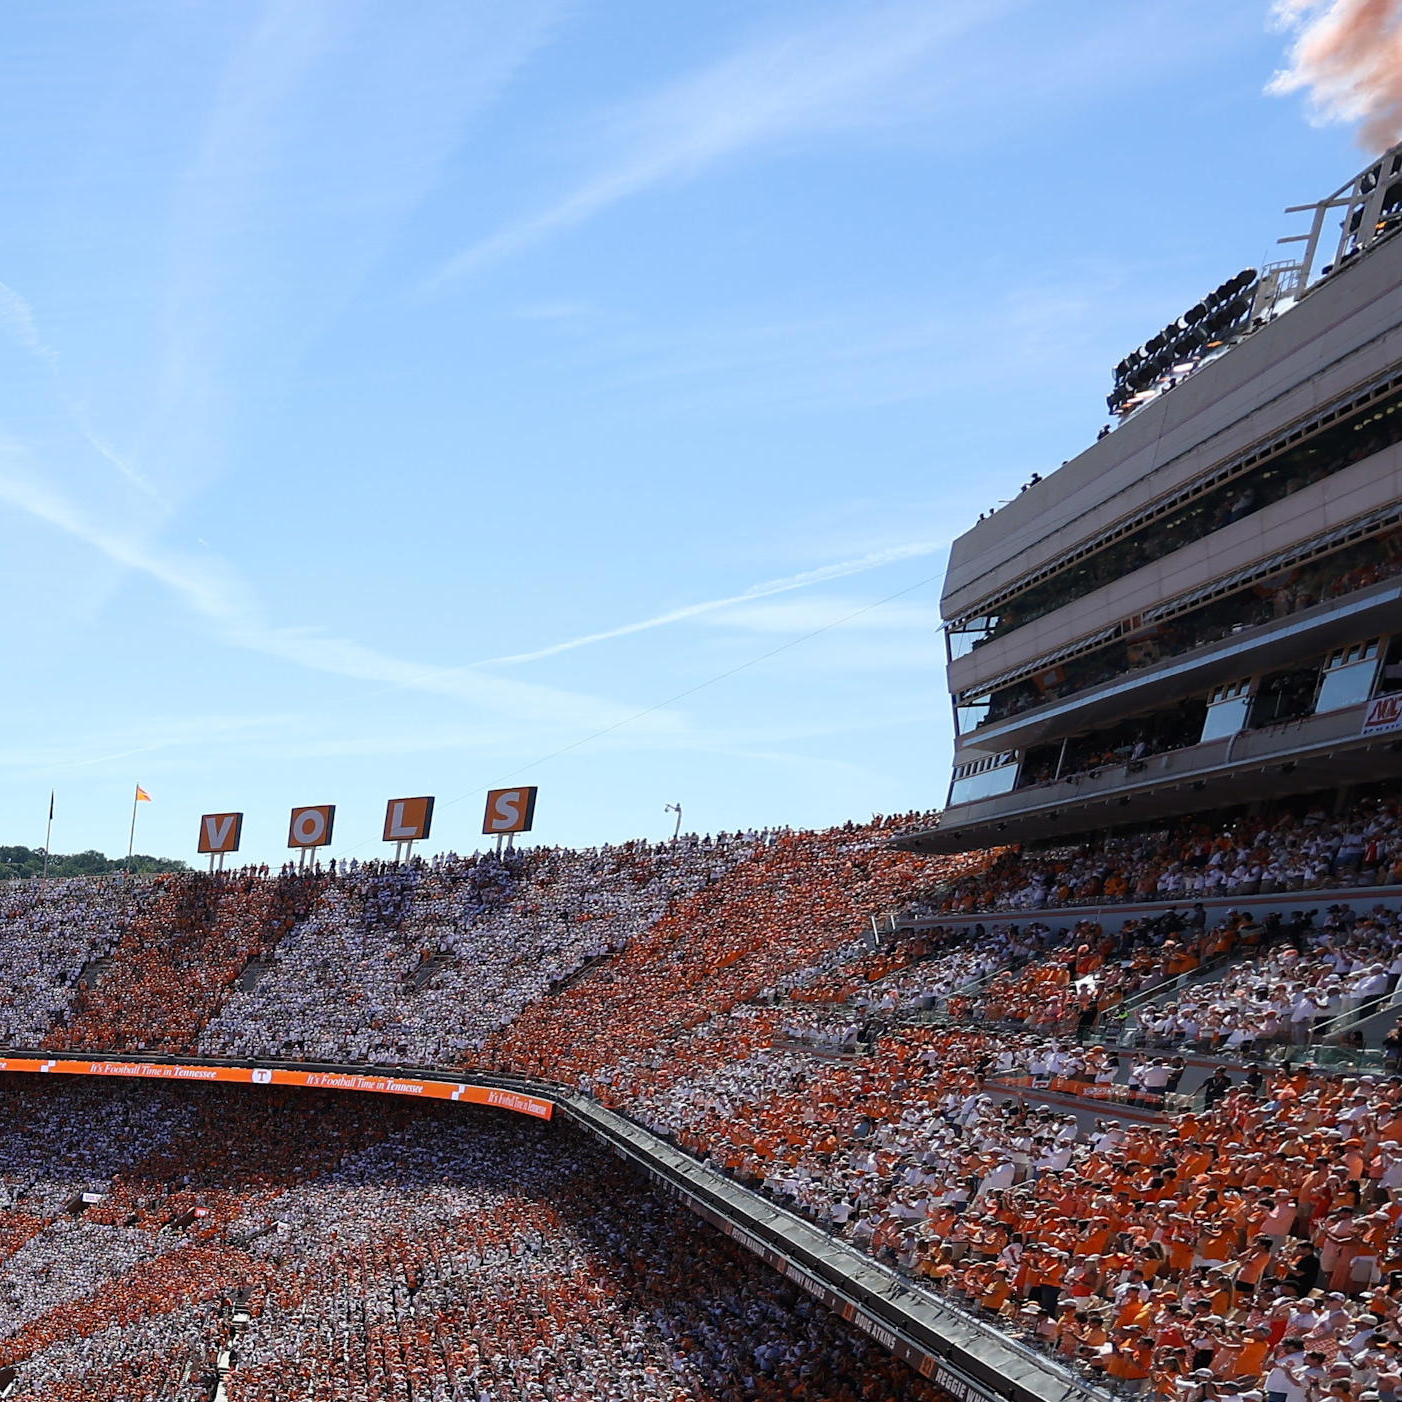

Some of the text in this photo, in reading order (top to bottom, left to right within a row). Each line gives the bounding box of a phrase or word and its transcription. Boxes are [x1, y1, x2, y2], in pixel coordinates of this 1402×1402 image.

[89, 1064, 217, 1078] It's Football Time in Tennessee
[307, 1074, 424, 1092] It's Football Time in Tennessee
[854, 1311, 875, 1334] DOUG
[871, 1322, 897, 1350] ATKINS
[934, 1367, 968, 1399] REGGIE
